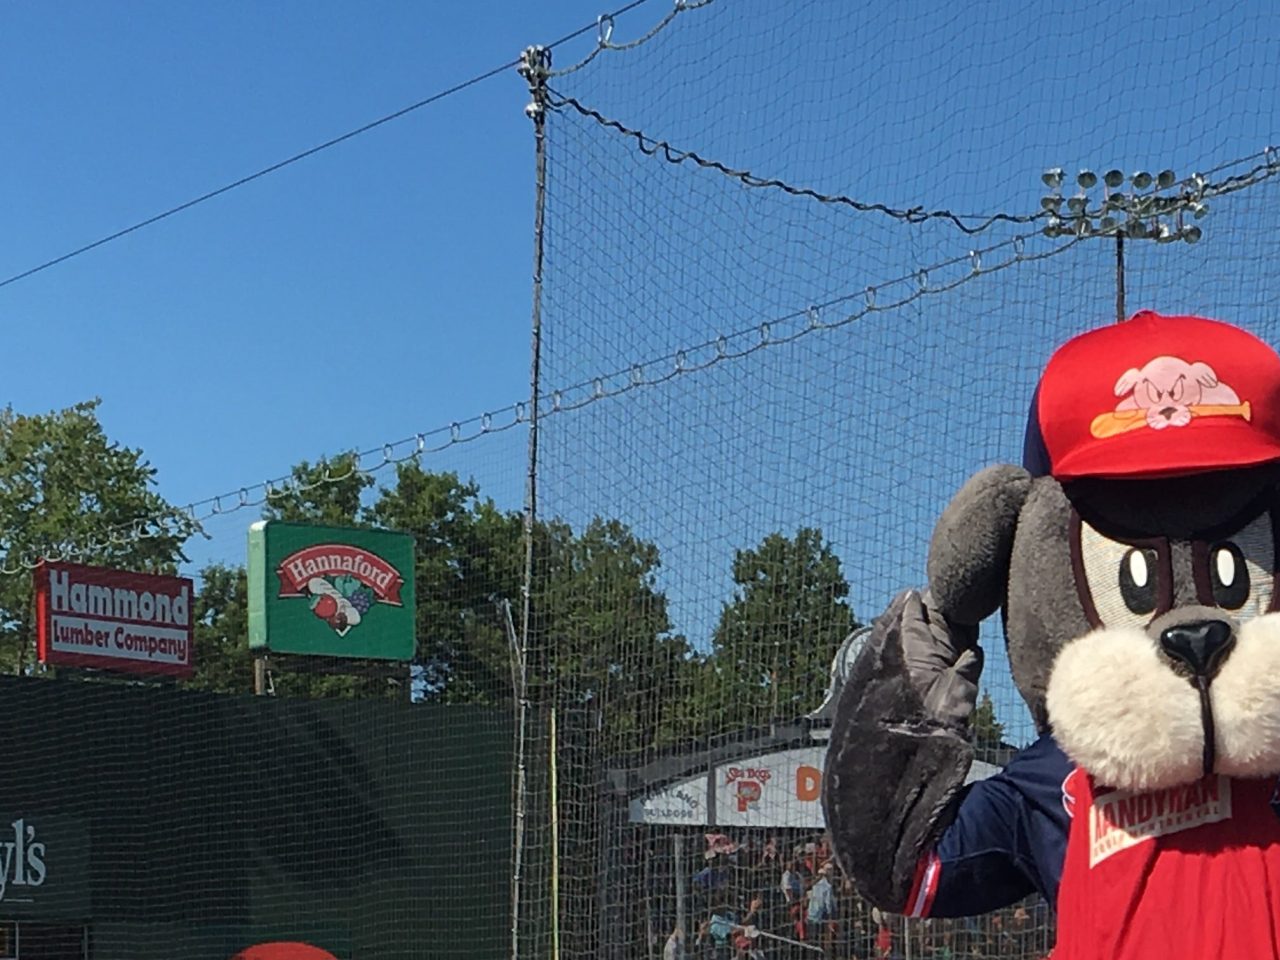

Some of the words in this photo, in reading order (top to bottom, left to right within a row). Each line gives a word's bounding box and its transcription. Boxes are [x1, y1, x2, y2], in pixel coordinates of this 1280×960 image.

[287, 554, 394, 589] Hannaford
[49, 569, 190, 626] Hammond
[53, 619, 111, 649] Lumber
[114, 627, 187, 662] Company
[0, 818, 46, 900] yl's
